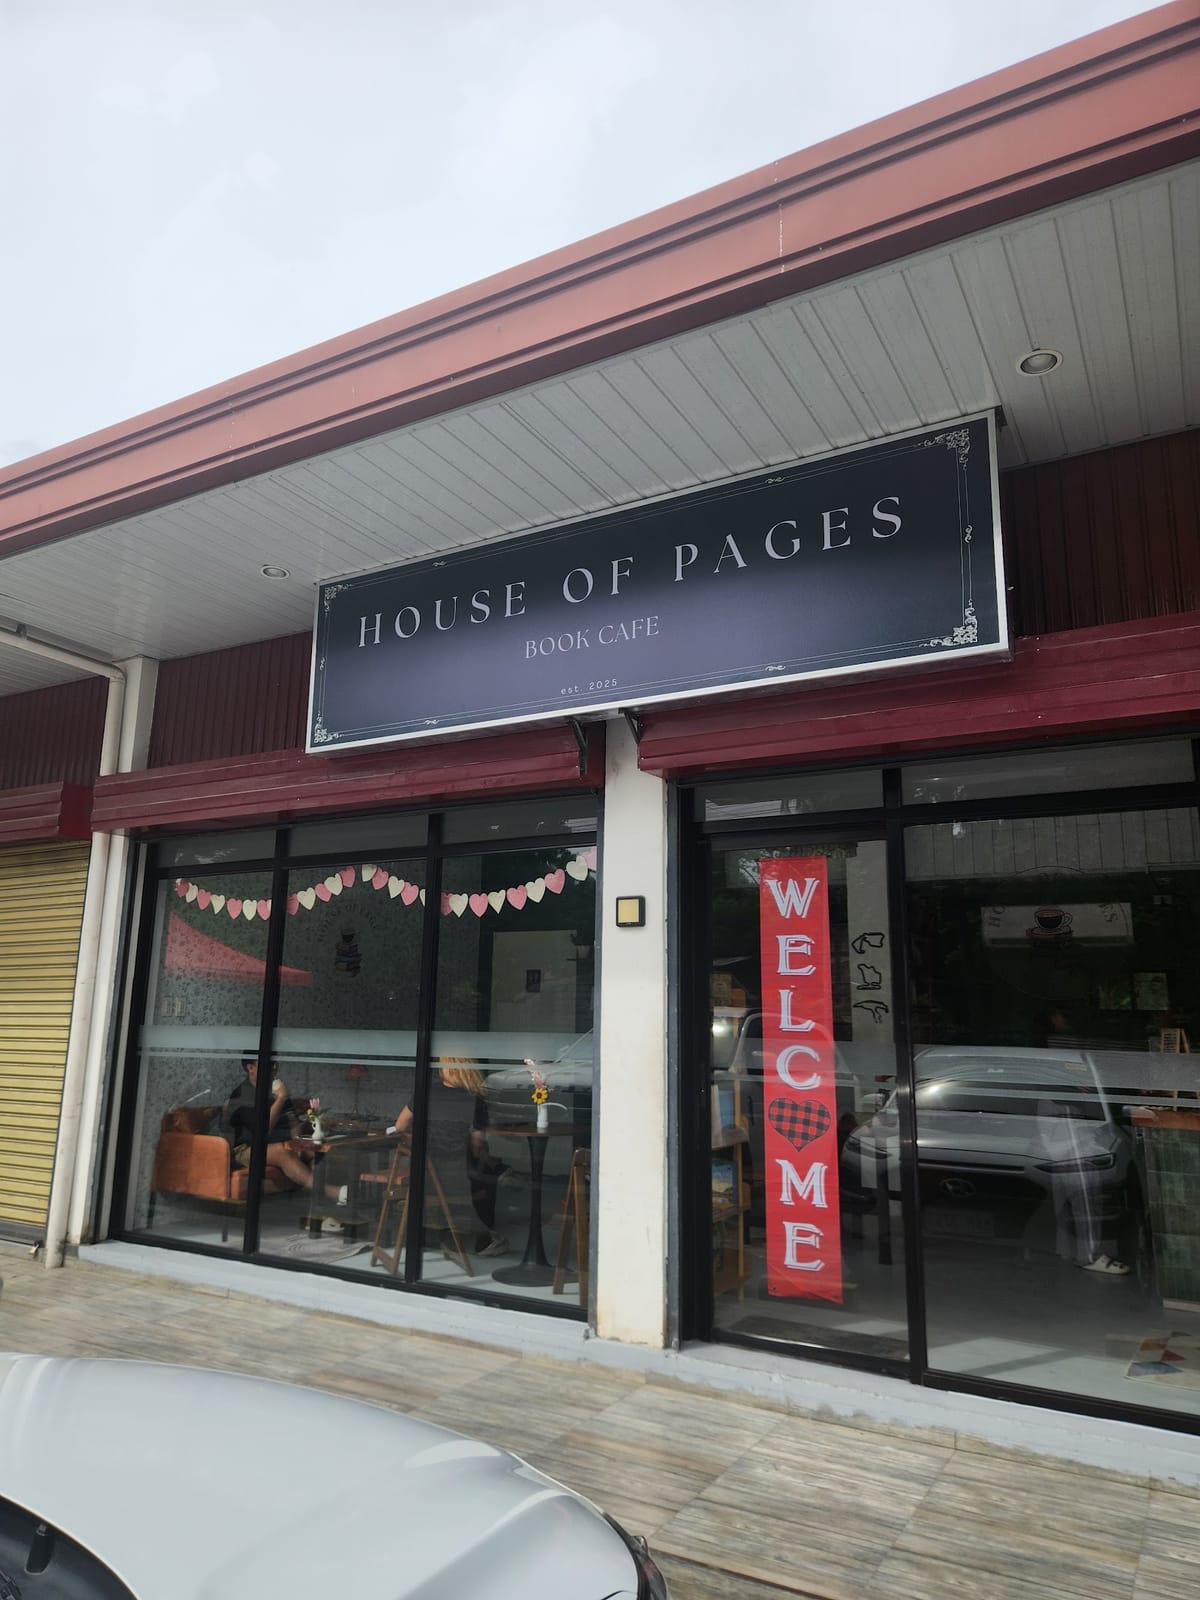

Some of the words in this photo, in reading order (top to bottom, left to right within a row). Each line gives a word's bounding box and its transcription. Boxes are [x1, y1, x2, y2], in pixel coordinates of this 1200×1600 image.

[358, 581, 527, 648] HOUSE
[562, 556, 634, 604] OF
[674, 496, 902, 582] PAGES
[524, 629, 591, 659] BOOK
[597, 615, 660, 645] CAFE
[560, 684, 584, 695] est.
[588, 678, 618, 691] 2025
[763, 877, 829, 1272] WELCME
